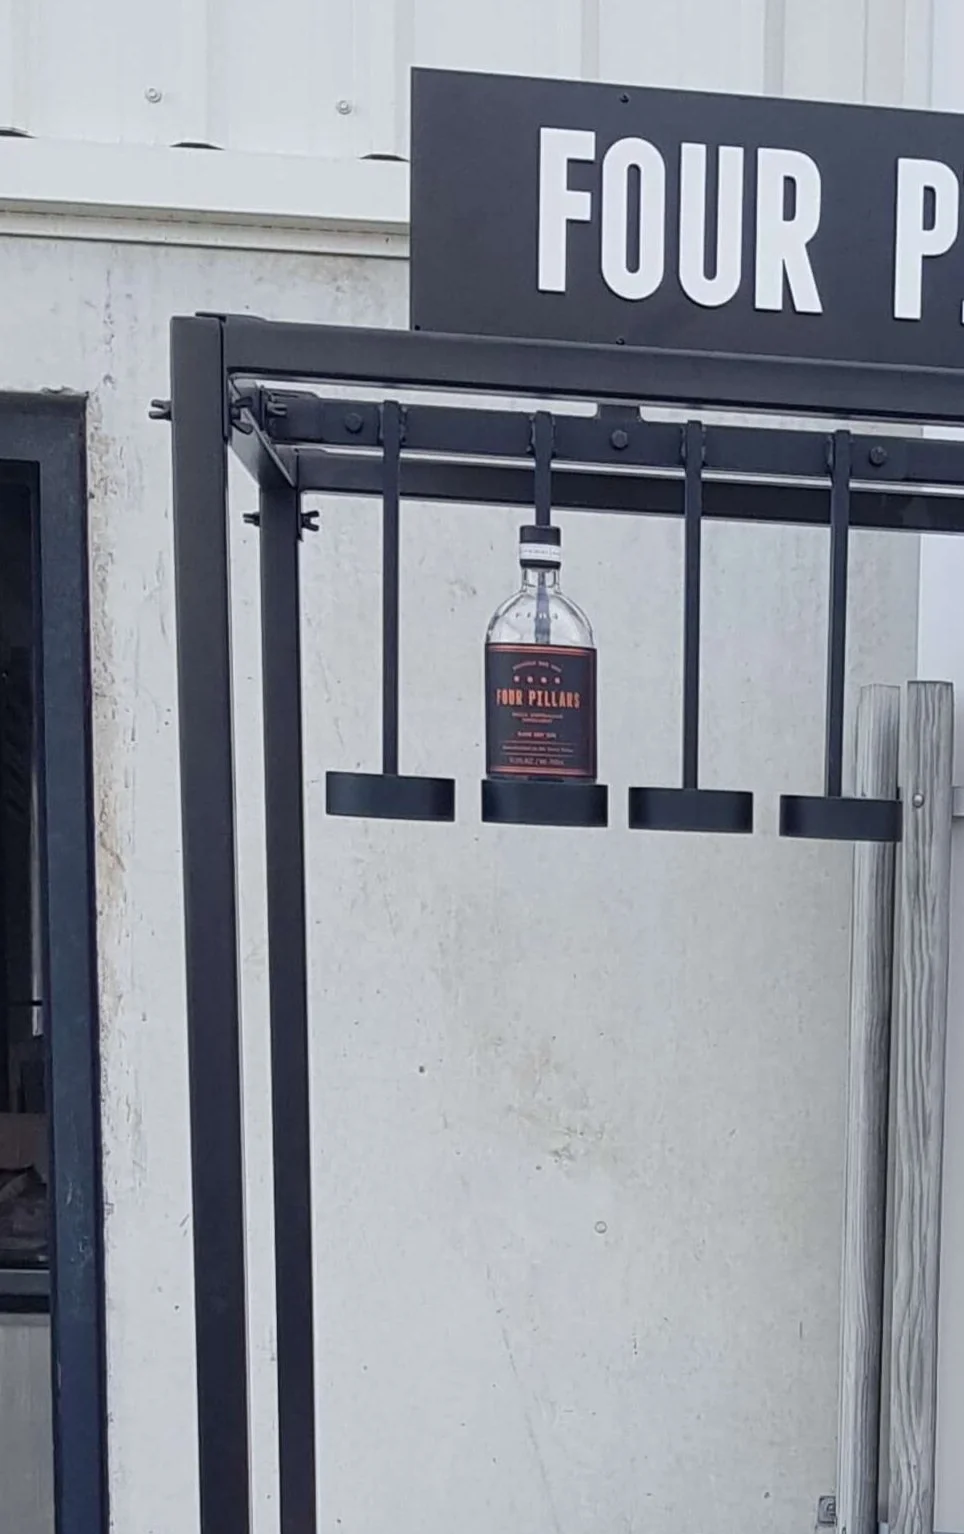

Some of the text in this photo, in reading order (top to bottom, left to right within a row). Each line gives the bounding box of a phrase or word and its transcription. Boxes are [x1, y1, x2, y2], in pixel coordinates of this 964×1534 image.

[538, 126, 823, 313] FOUR
[496, 688, 581, 709] FOUR PILLARS
